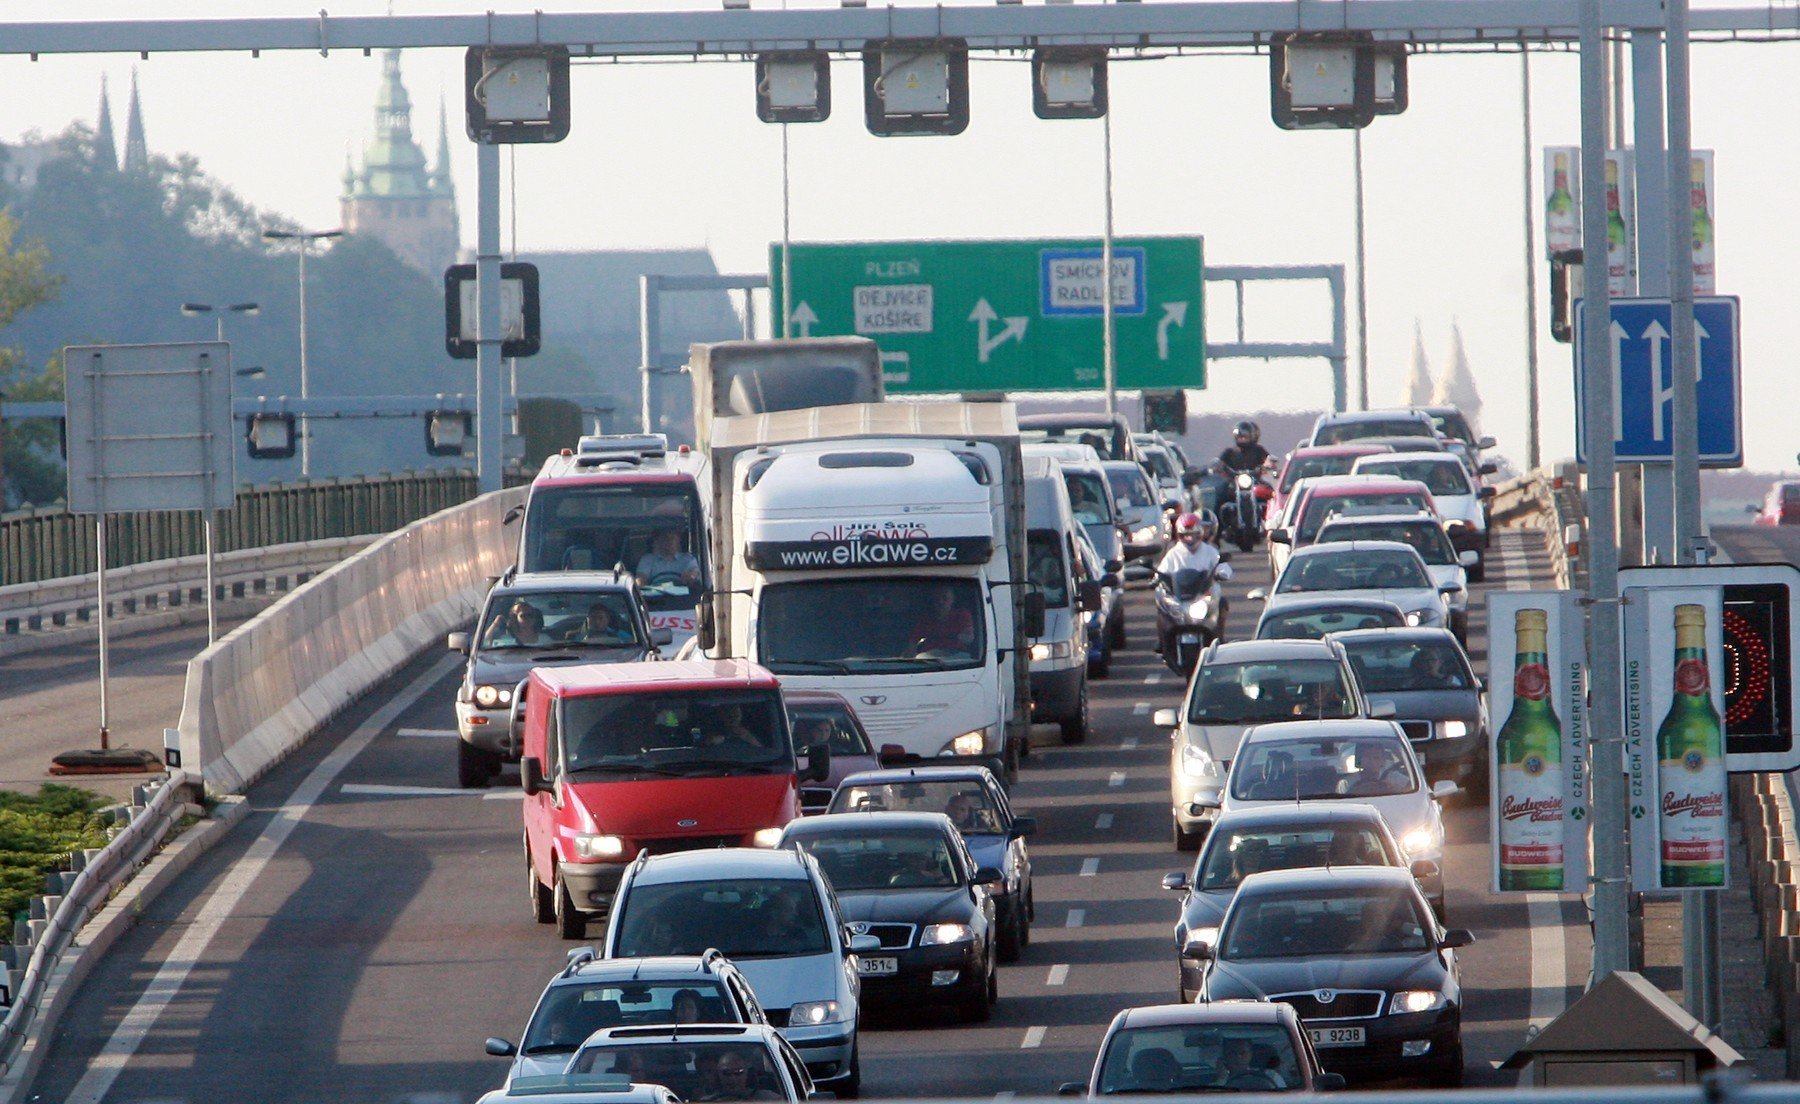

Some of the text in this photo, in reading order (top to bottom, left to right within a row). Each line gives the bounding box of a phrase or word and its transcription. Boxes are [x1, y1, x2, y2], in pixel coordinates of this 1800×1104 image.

[859, 289, 928, 306] DEJVICE
[781, 541, 957, 566] www.elkawe.cz
[1571, 662, 1583, 798] CZECH ADVERTISING
[1630, 660, 1642, 797] CZECH ADVERTISING
[1330, 1029, 1360, 1042] 9238
